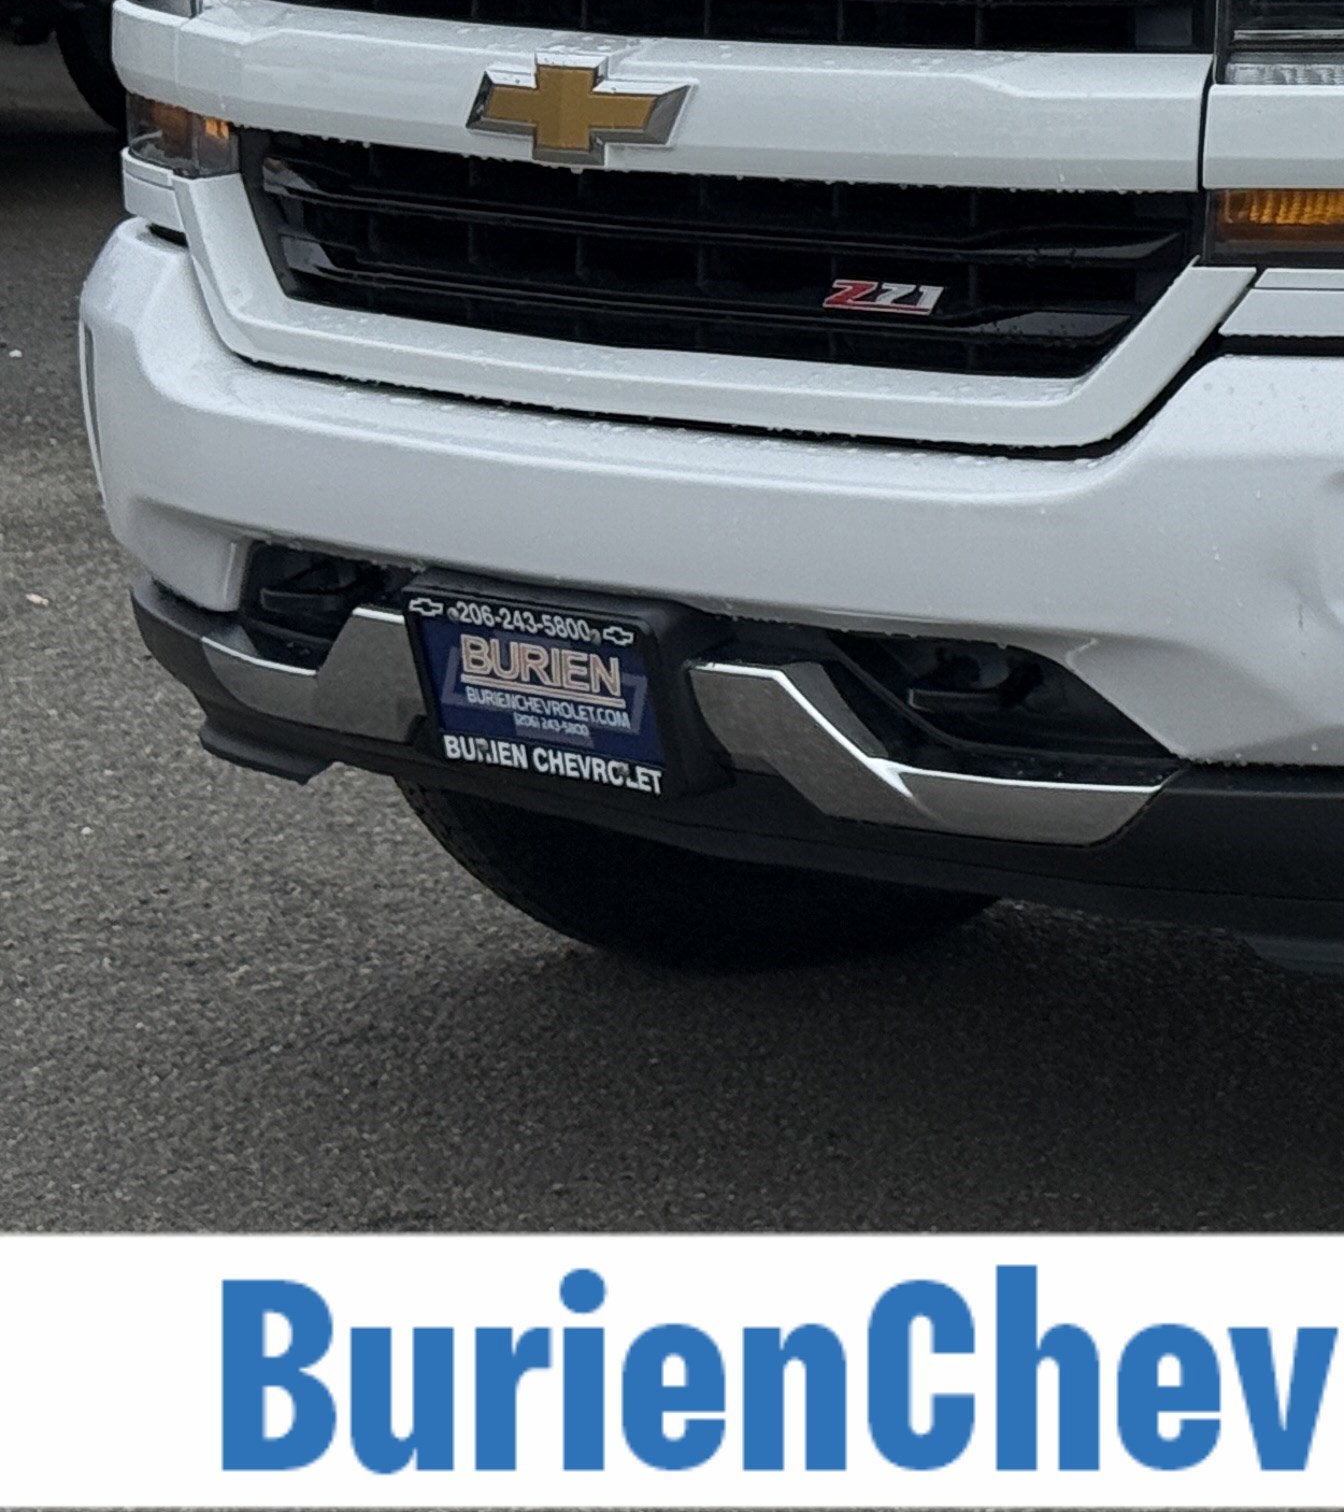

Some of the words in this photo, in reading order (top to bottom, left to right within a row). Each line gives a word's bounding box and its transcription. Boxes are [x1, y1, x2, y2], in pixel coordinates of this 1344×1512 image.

[822, 278, 944, 316] Z71
[456, 600, 593, 642] 206-243-5800
[460, 633, 622, 697] BURIEN
[466, 686, 631, 729] BURIENCHEVROLET.COM
